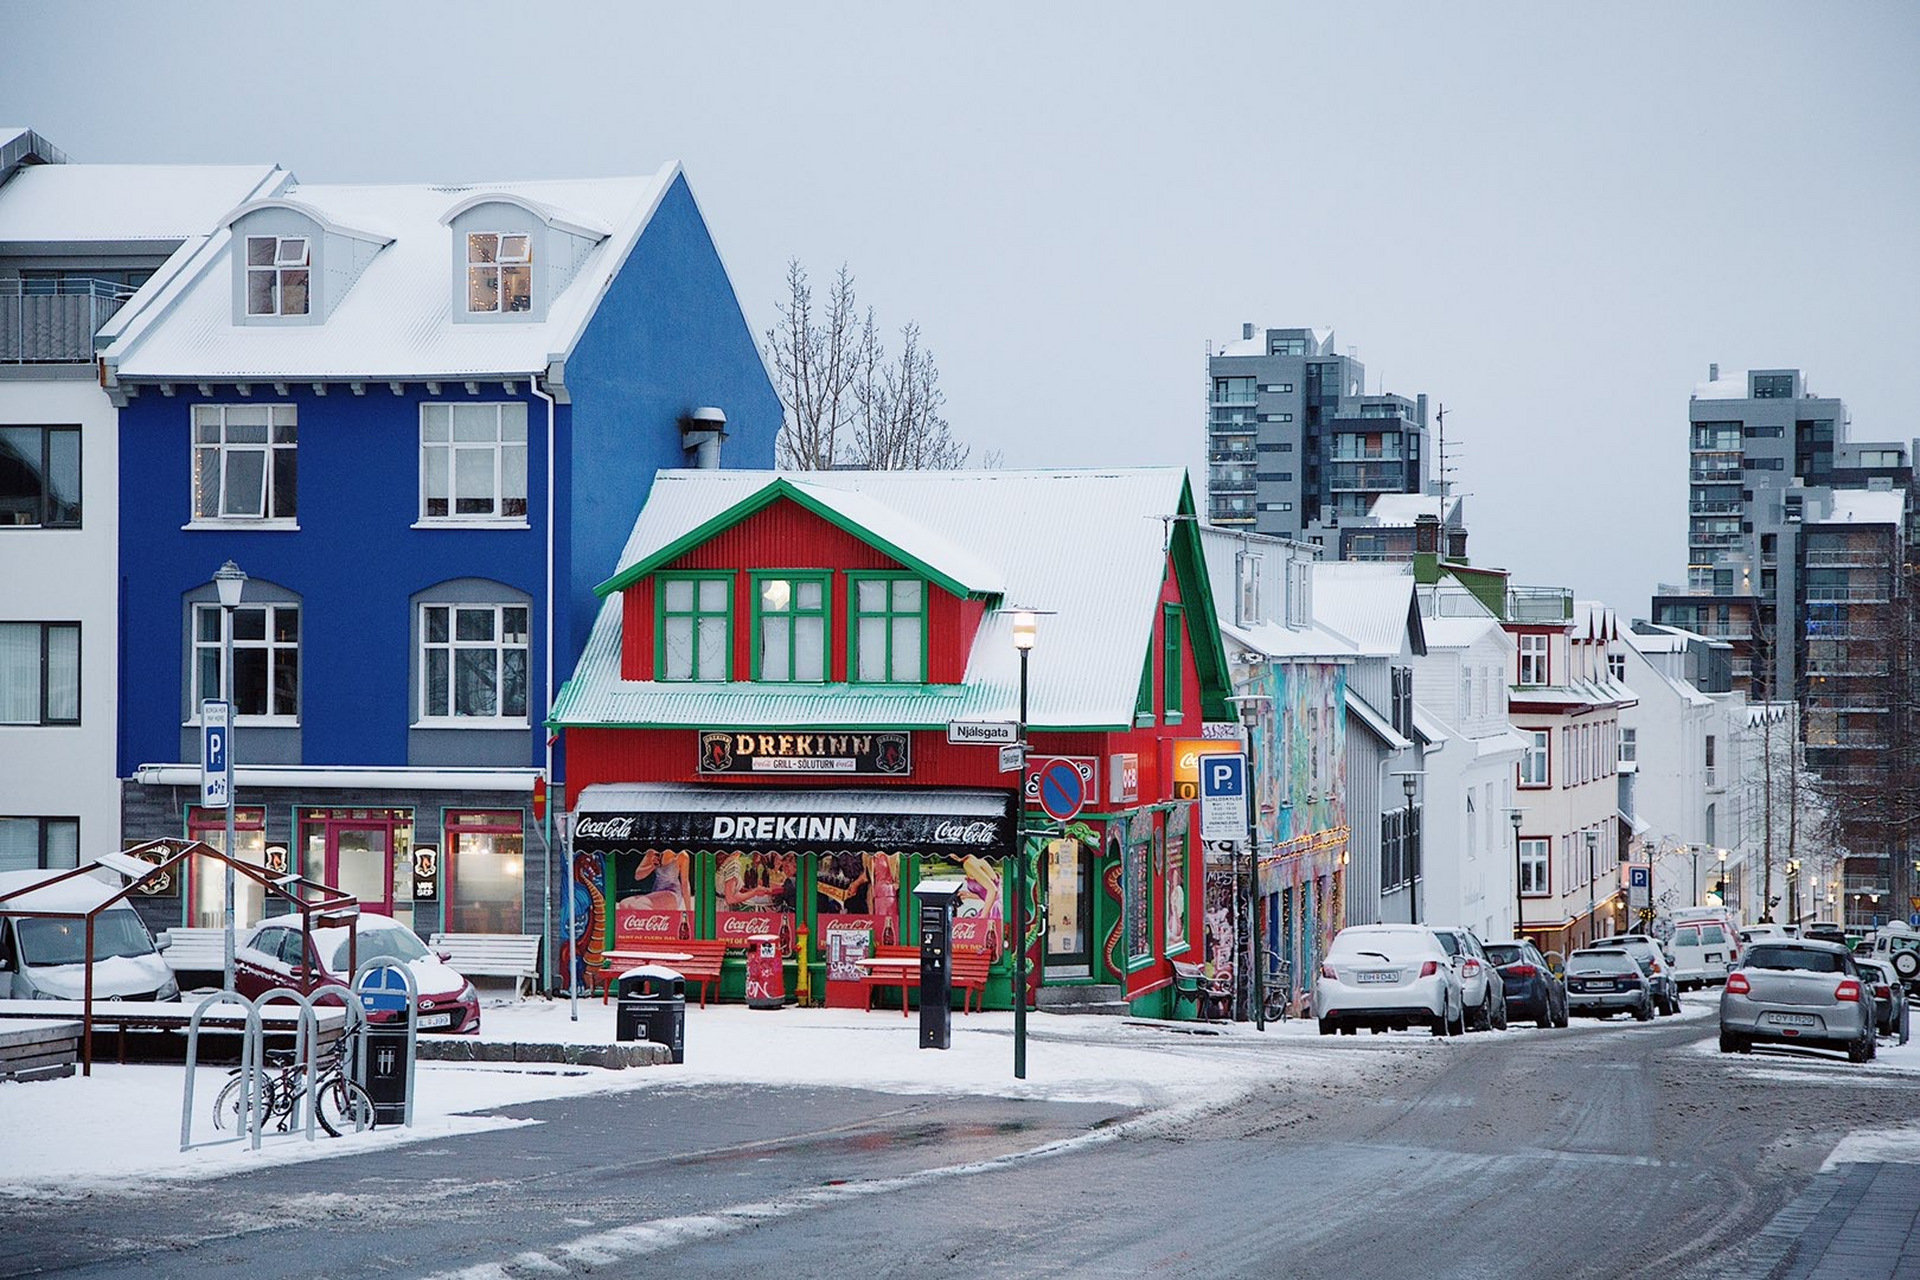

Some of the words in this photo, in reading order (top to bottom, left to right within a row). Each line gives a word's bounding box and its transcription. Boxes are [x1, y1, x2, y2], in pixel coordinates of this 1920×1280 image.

[957, 726, 1009, 739] Njálsgata
[210, 733, 221, 763] P
[736, 734, 872, 756] DREKINN
[1213, 765, 1232, 790] P
[575, 816, 637, 839] Coca-Cola
[712, 816, 857, 840] DREKINN
[934, 820, 998, 843] Coca-Cola
[623, 914, 670, 931] Coca-Cola
[723, 917, 770, 934] Coca-Cola
